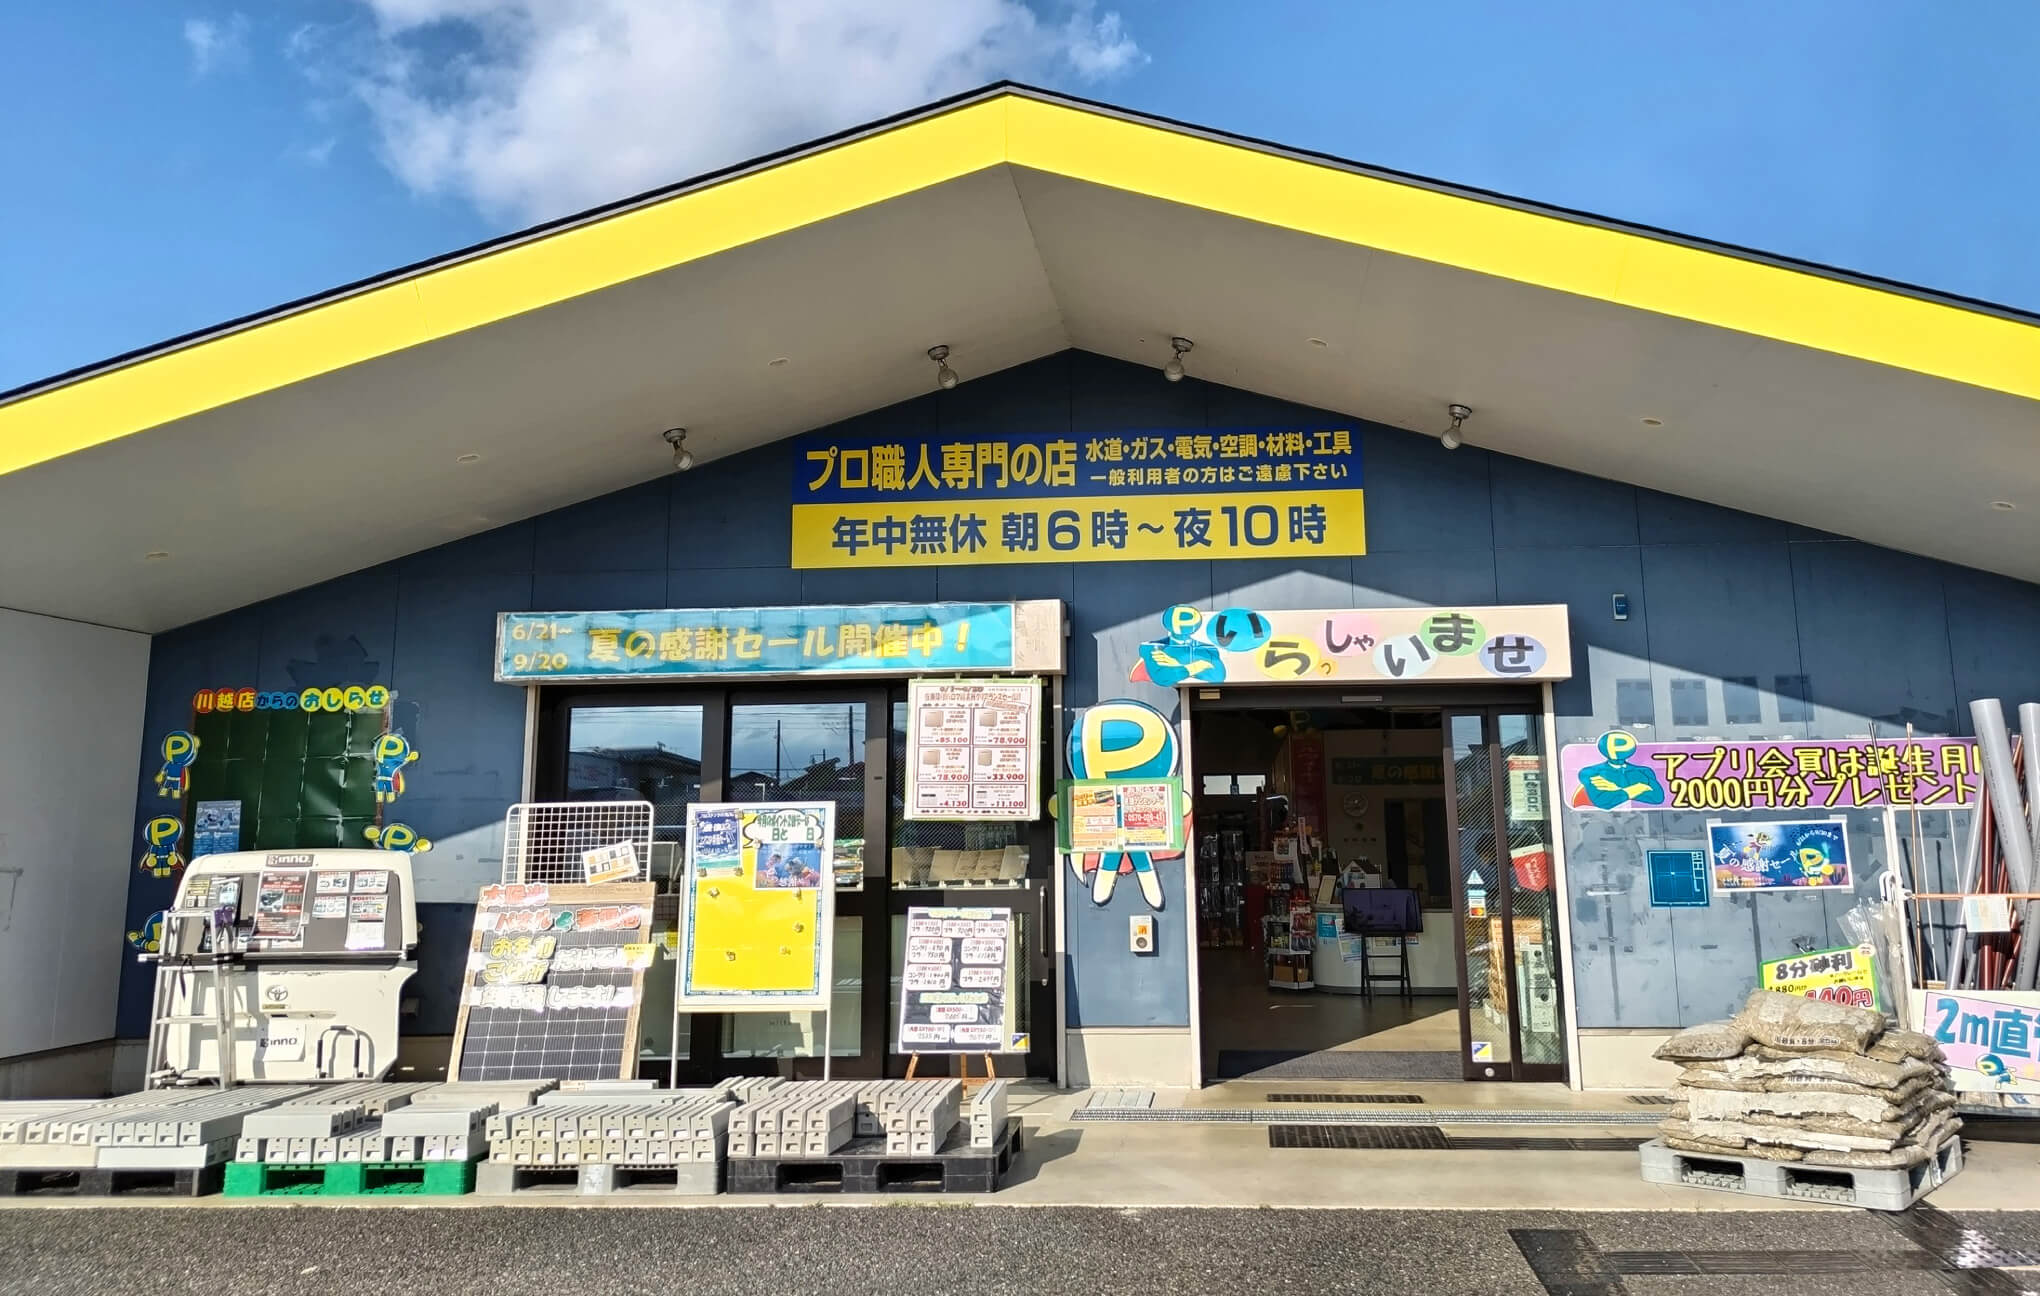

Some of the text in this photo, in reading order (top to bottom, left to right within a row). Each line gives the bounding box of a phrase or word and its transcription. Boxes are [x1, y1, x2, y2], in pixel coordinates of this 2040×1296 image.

[806, 431, 1352, 492] プロ職人専門の店 水道・ガス・電気・空調・材料・工具
[1089, 463, 1348, 485] 一般利用者の方はご遠慮下さい
[831, 513, 987, 555] 年中無休
[513, 652, 568, 671] 9/20
[1670, 773, 1978, 808] 2000円分プレゼント
[1714, 843, 1800, 873] 夏の感謝セール
